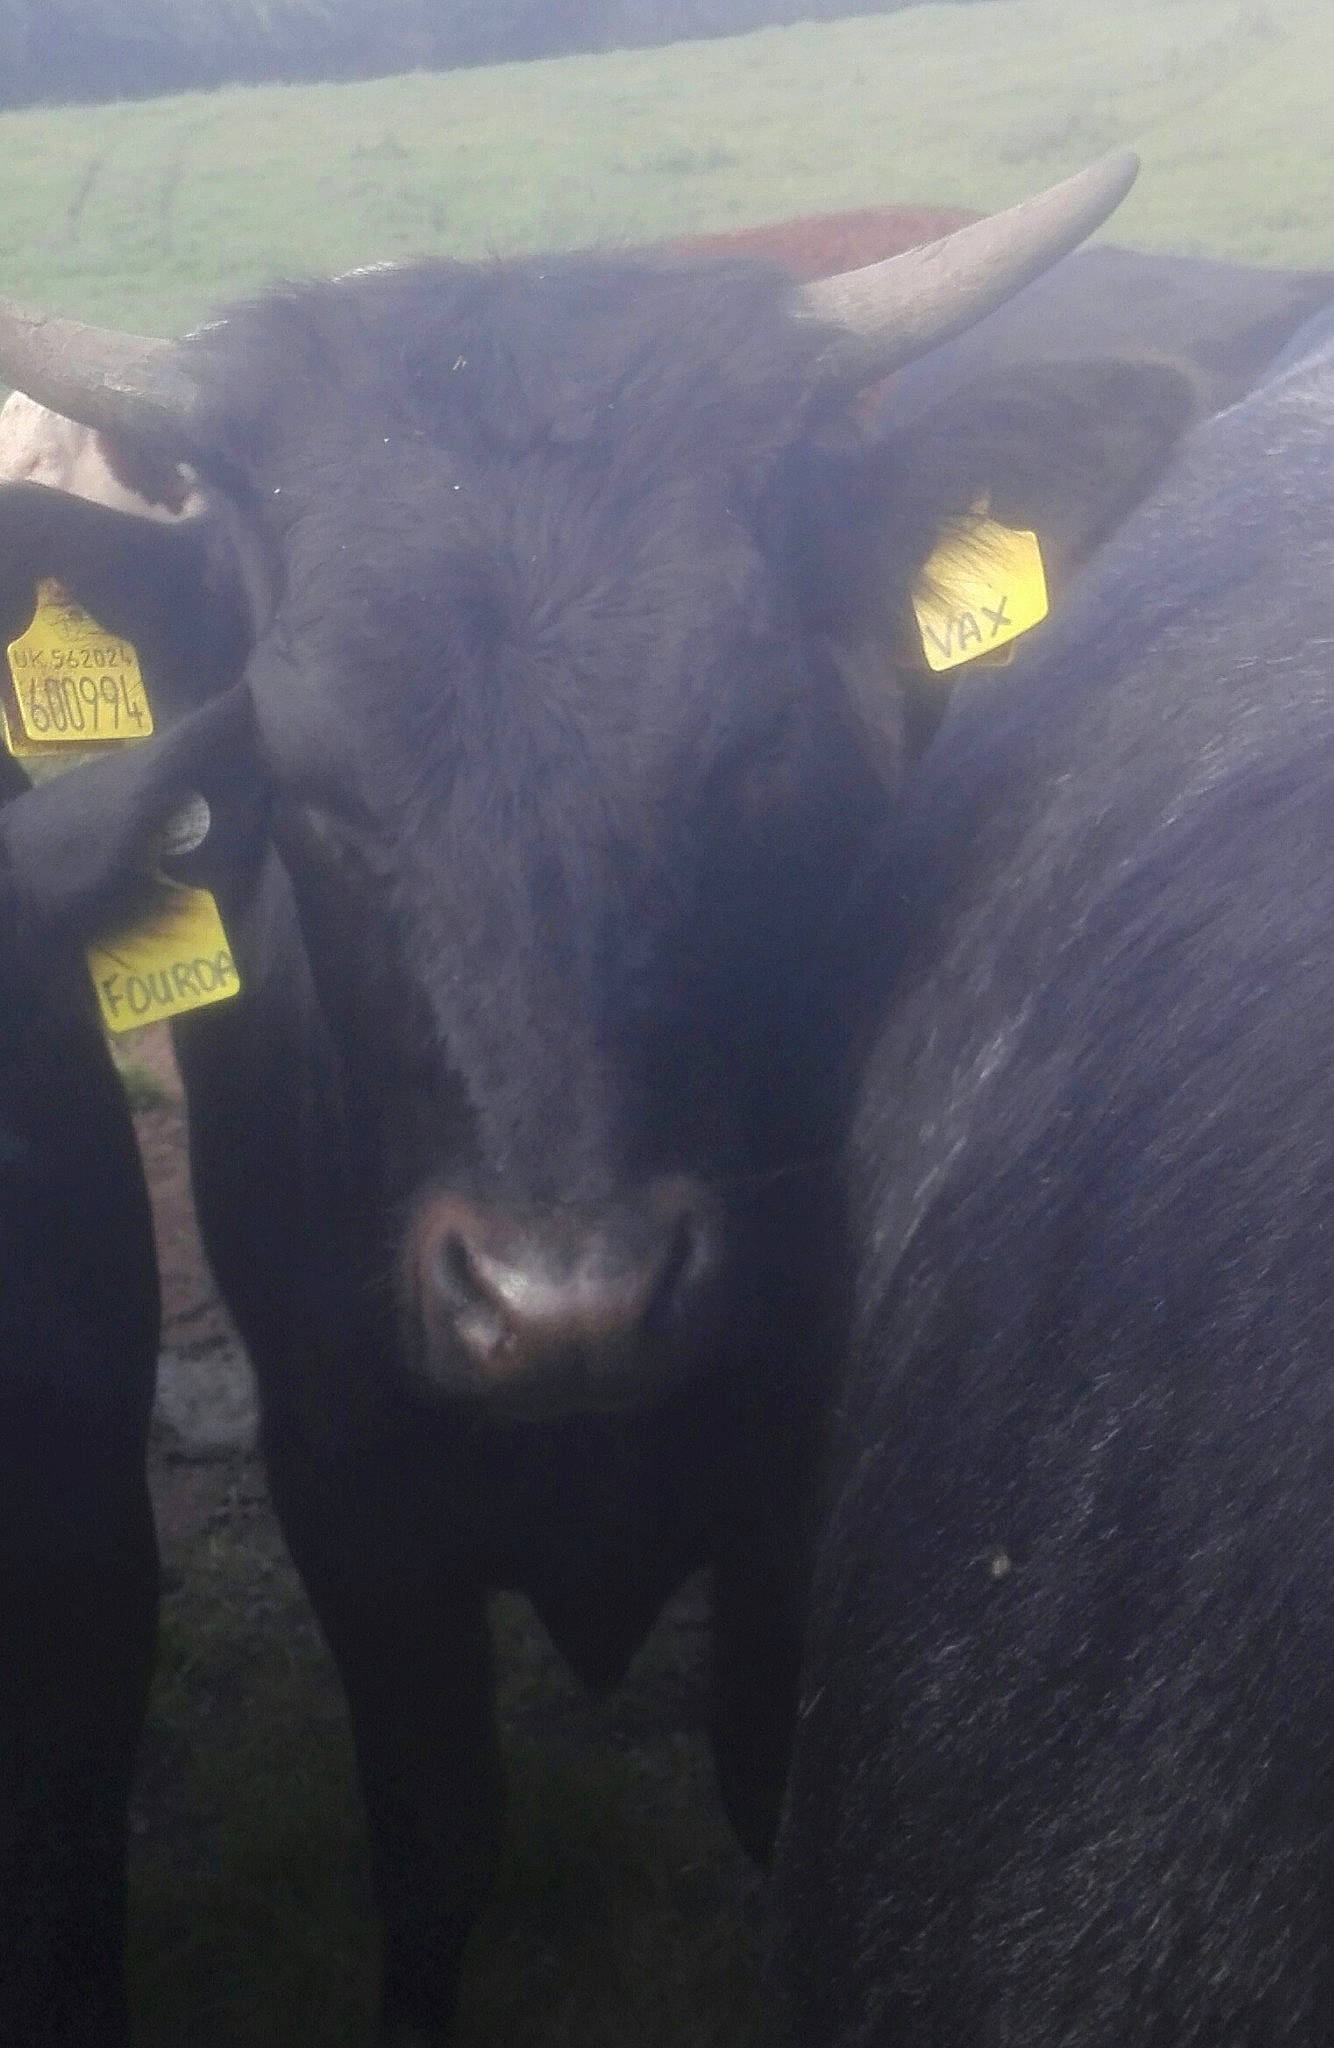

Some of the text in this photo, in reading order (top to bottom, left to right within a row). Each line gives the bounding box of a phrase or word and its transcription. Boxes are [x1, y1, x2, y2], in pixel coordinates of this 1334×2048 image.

[923, 596, 1012, 658] VAX
[13, 649, 43, 669] UK
[28, 674, 143, 732] 600994
